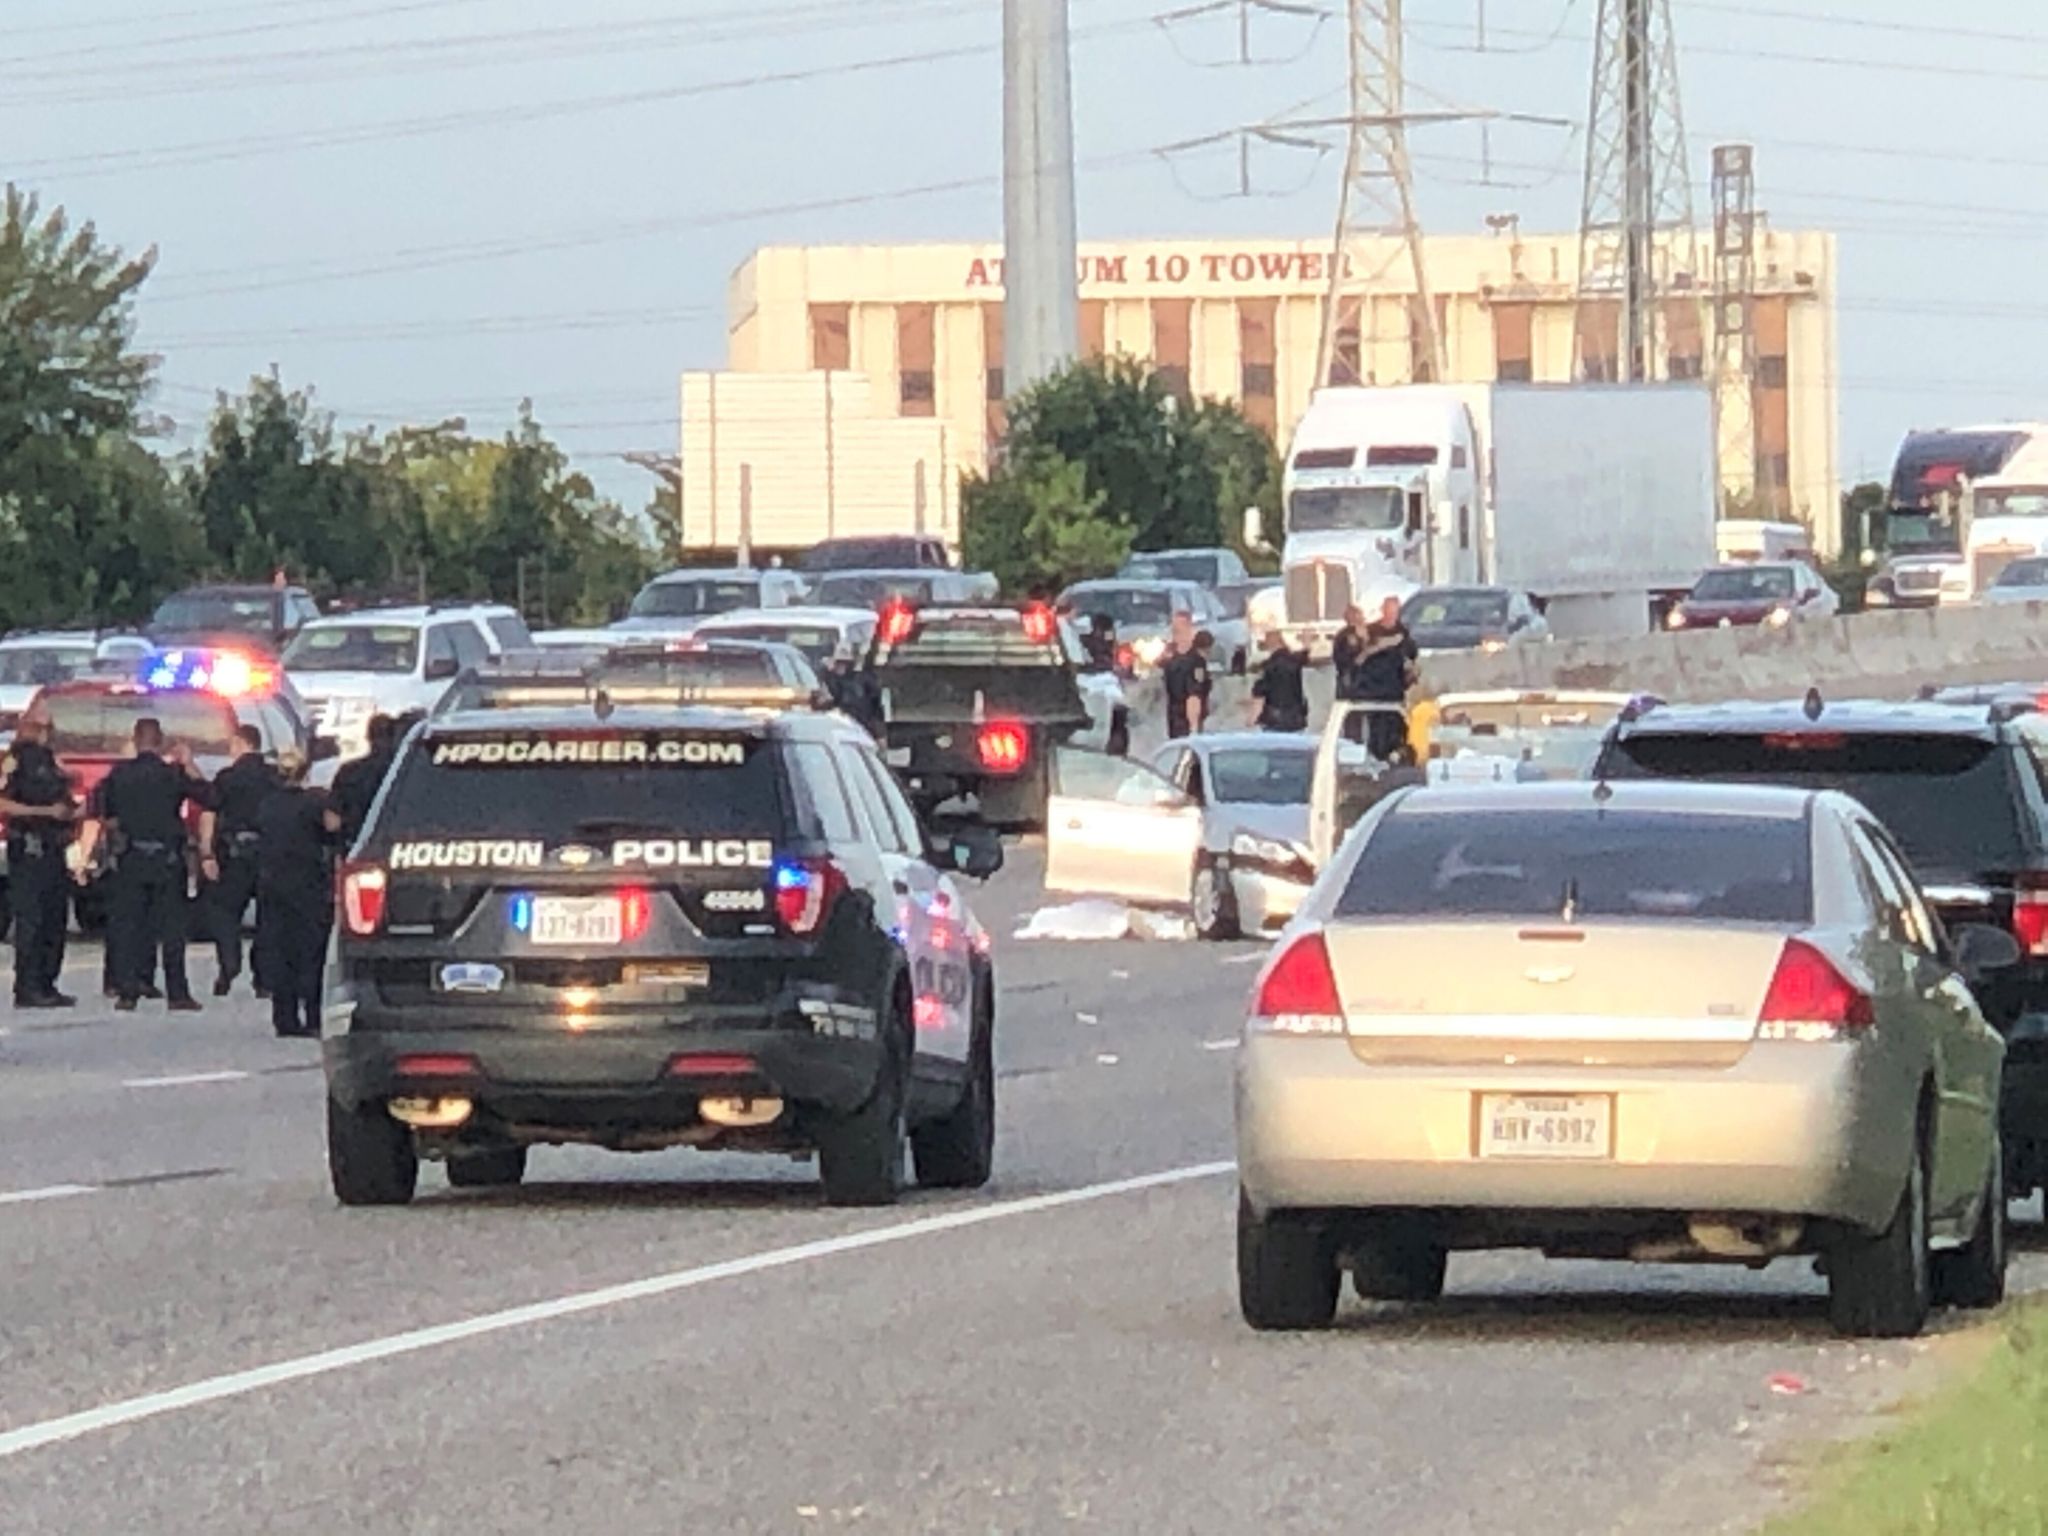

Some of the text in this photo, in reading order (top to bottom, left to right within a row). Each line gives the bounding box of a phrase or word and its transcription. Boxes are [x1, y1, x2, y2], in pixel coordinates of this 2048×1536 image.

[966, 255, 1128, 286] ATUM
[1146, 254, 1189, 283] 10
[433, 741, 744, 765] HPDCAREER.COM
[390, 840, 773, 868] HOUSTON POLICE
